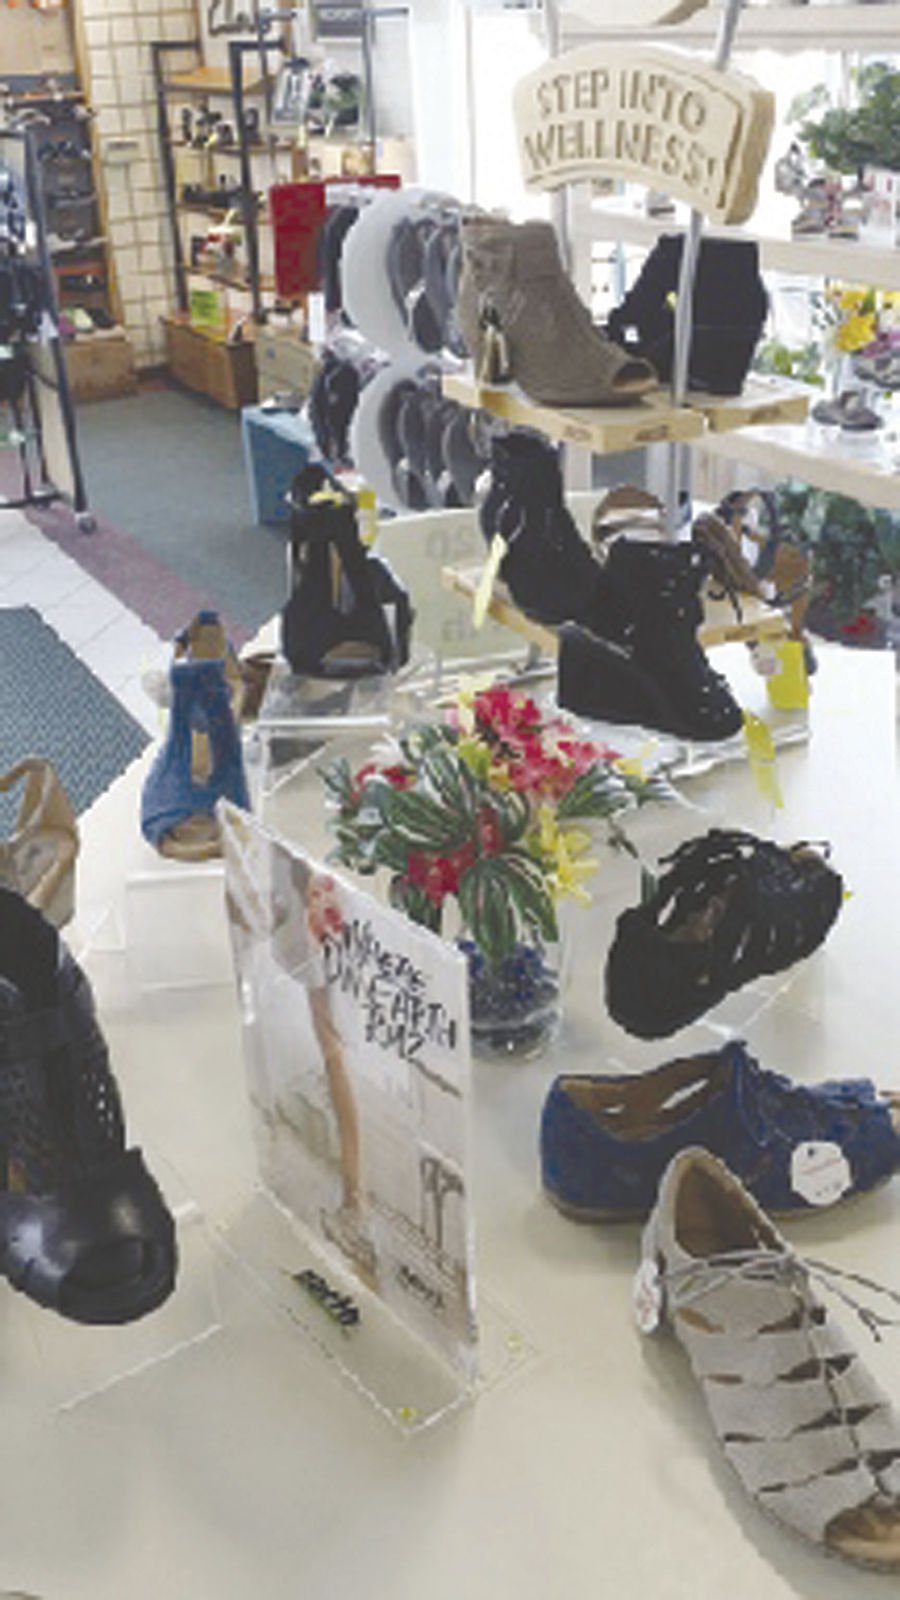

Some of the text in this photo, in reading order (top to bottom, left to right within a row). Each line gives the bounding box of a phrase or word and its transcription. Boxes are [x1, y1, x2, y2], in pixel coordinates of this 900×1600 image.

[537, 67, 707, 134] STEP INTO
[524, 118, 716, 196] WELLNESS!
